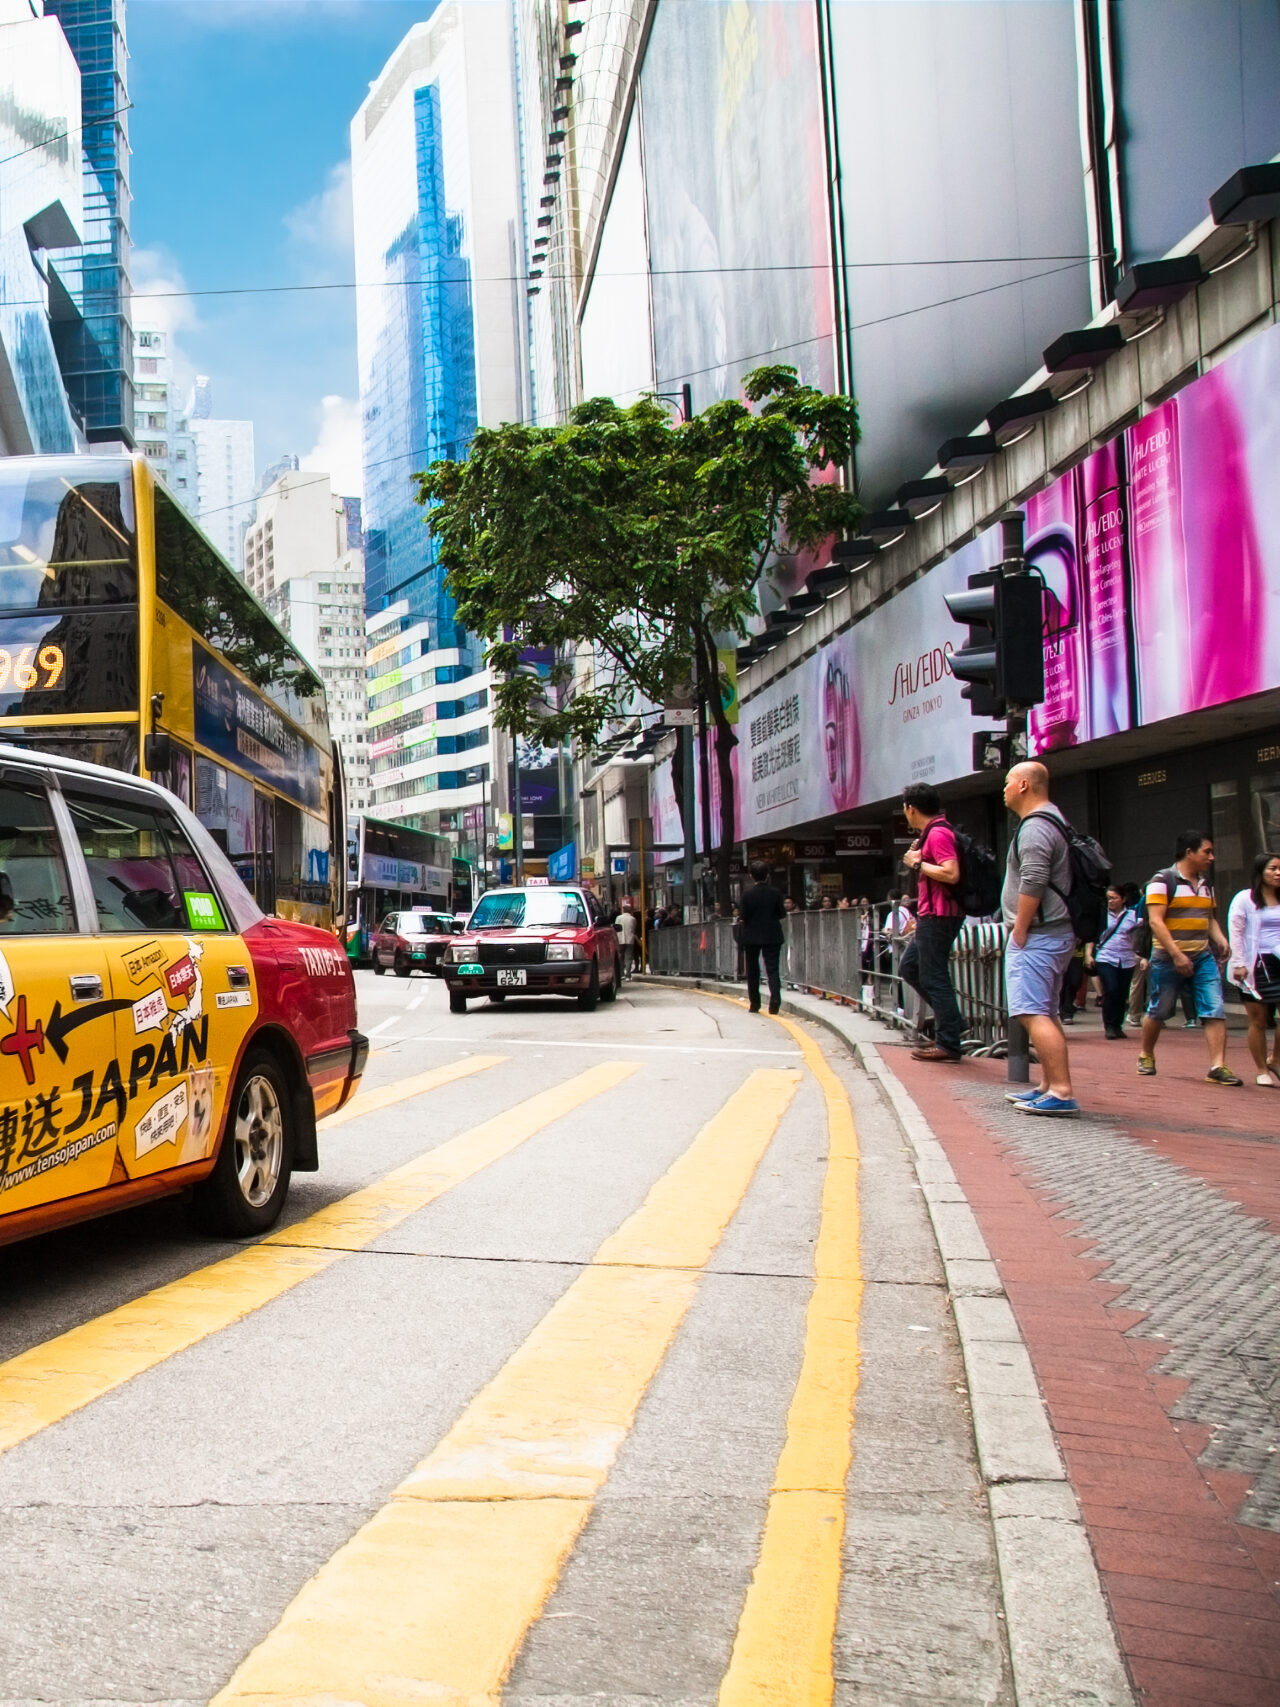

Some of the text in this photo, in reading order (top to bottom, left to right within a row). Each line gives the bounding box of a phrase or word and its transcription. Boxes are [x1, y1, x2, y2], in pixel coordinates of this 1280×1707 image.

[1131, 427, 1172, 467] SHISEIDO
[1082, 507, 1125, 547] SHISEIDO
[1084, 534, 1125, 565] WHITE LUCENT
[888, 641, 955, 706] SHISEIDO
[902, 695, 943, 724] GINZA TOKYO
[847, 836, 870, 848] 500
[128, 948, 163, 977] 日本 Amazon
[500, 976, 524, 986] 6271
[135, 995, 165, 1027] 日本雅虎
